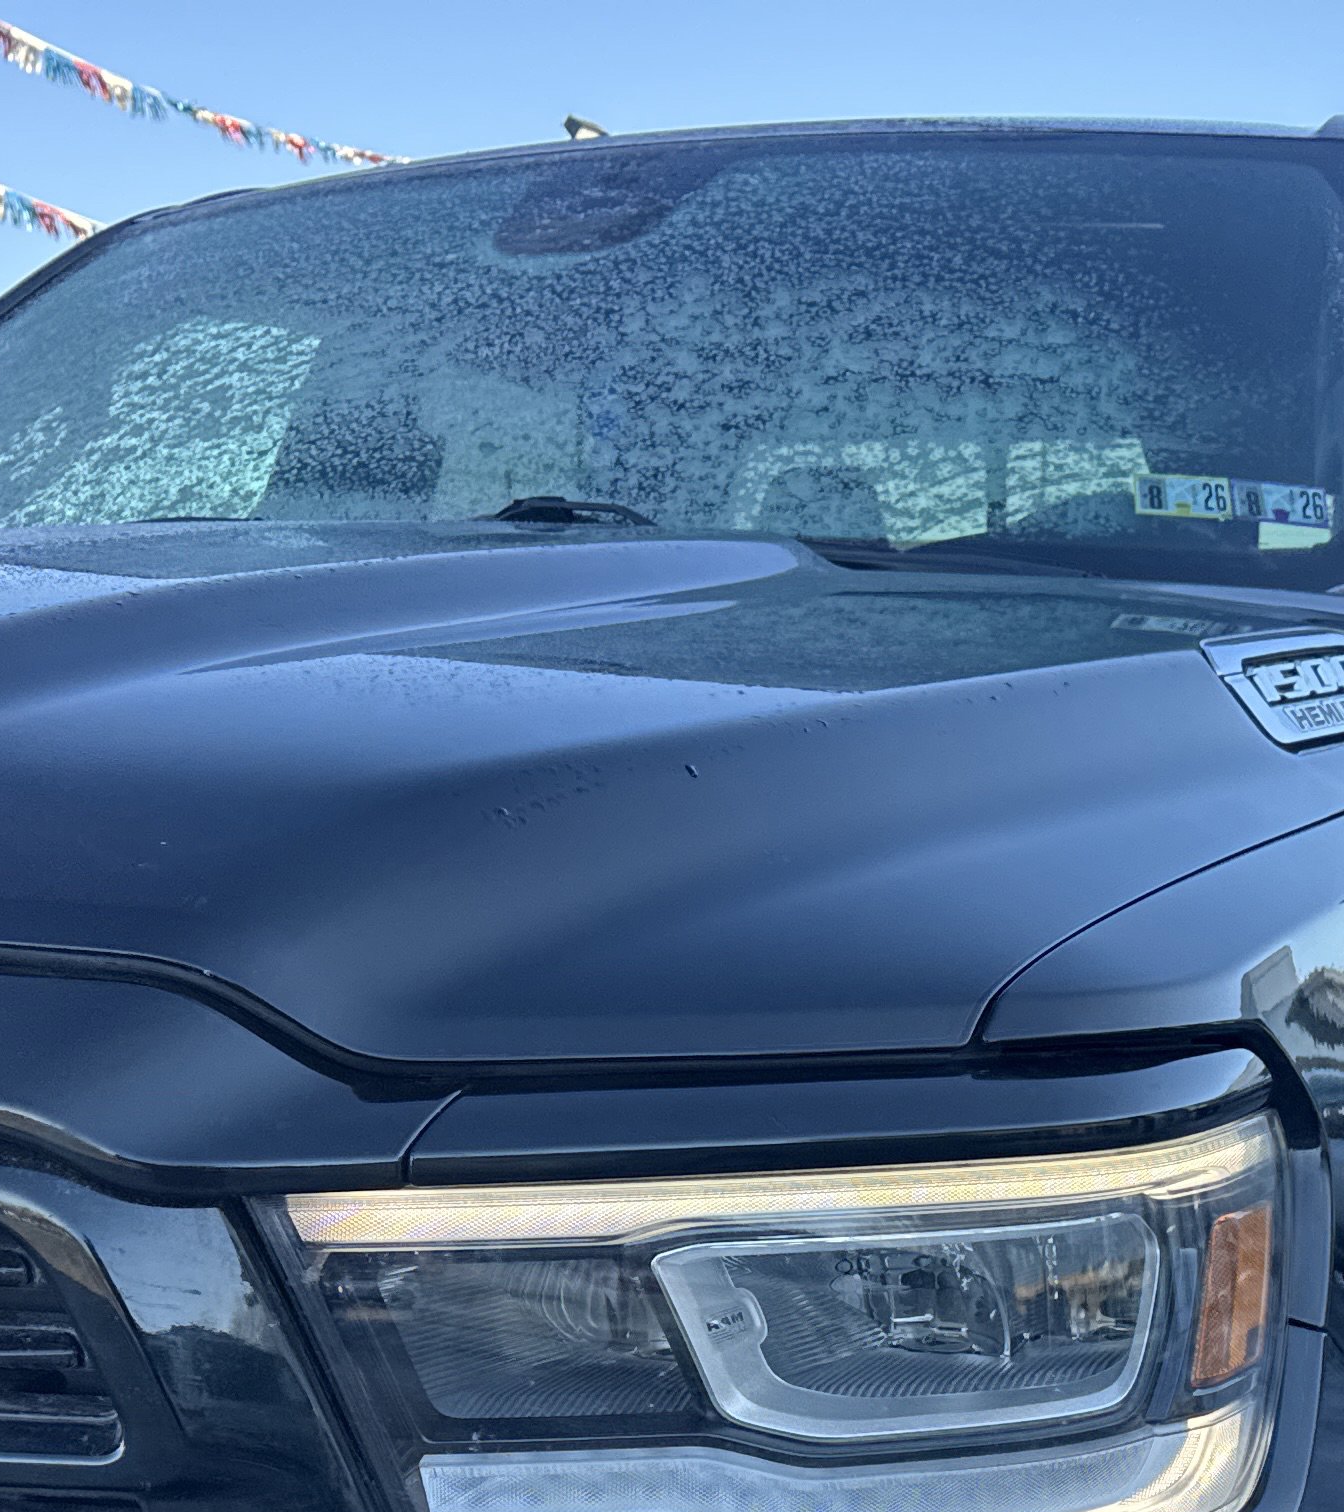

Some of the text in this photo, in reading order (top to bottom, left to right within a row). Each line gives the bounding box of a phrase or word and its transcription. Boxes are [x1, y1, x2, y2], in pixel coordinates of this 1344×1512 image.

[1202, 483, 1227, 512] 26
[1300, 491, 1324, 520] 26
[1290, 703, 1344, 729] HEMI
